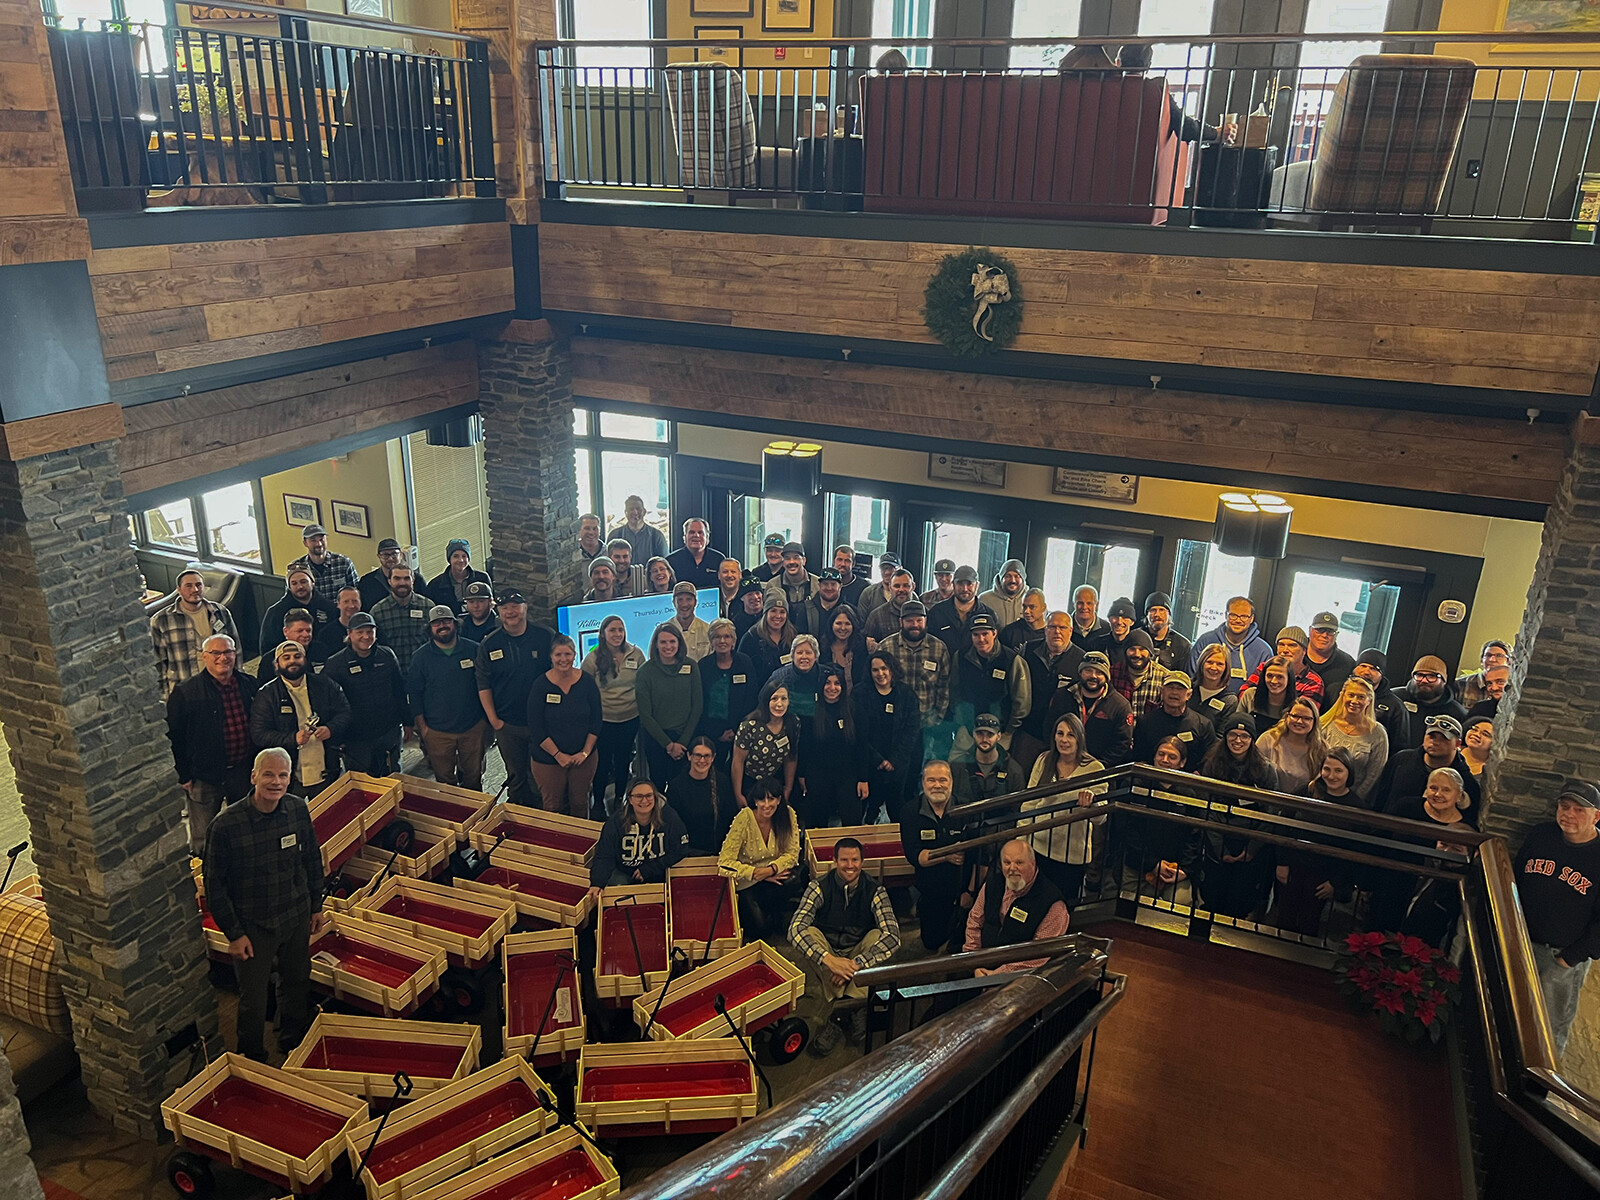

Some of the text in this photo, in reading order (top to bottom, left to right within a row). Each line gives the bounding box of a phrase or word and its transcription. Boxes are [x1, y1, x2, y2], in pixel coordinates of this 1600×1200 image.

[621, 832, 666, 861] SKI
[1524, 858, 1593, 895] RED SOX
